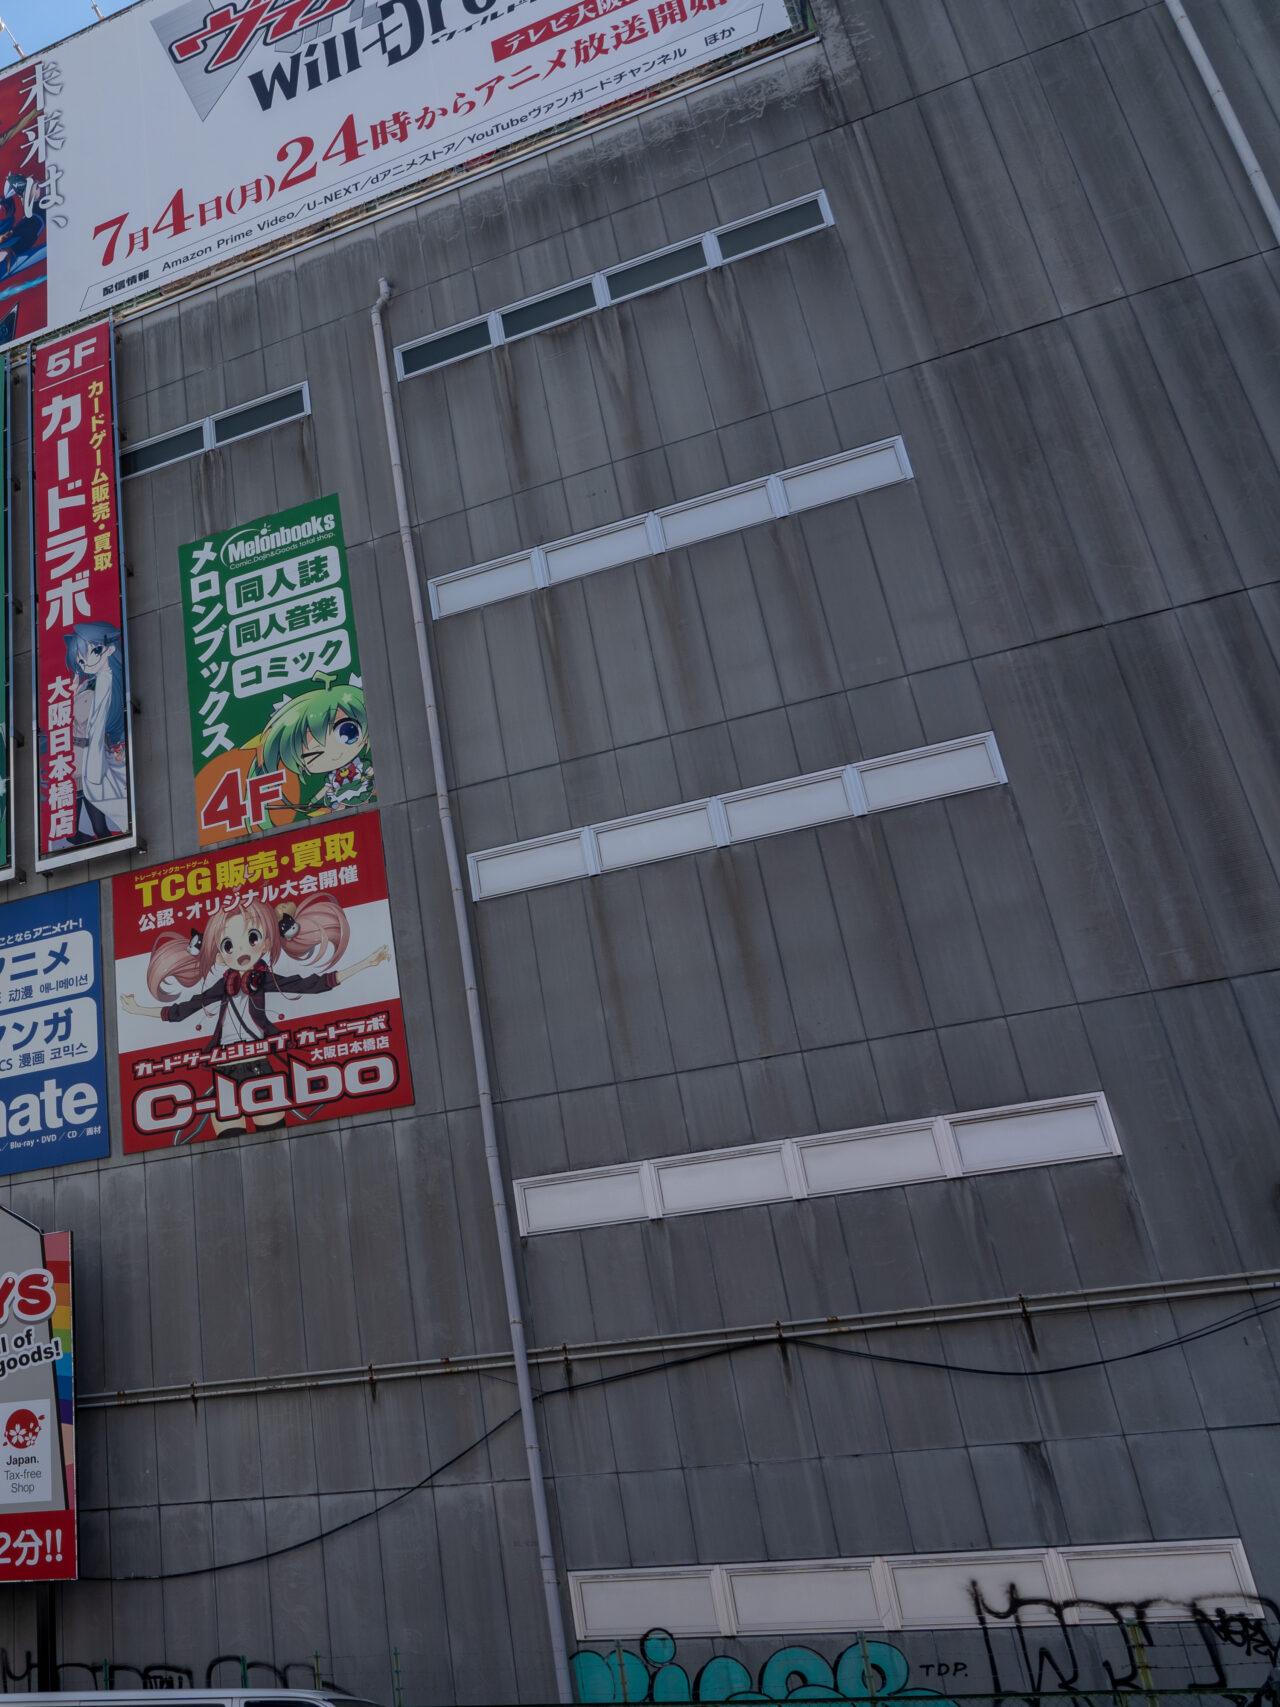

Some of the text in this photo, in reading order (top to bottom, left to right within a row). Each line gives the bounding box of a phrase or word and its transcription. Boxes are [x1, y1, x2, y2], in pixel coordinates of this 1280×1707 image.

[102, 25, 736, 297] 配信情報 Amazon Prime ほか
[46, 337, 97, 378] 5F
[88, 381, 113, 572] カードゲーム販売・買取
[41, 393, 91, 630] カードラボ
[228, 513, 336, 563] Melonbooks
[299, 538, 316, 548] total
[317, 532, 336, 544] shop.
[235, 555, 330, 608] 同人誌
[236, 596, 338, 648] 同人音楽
[190, 541, 235, 758] メロンブックス
[240, 637, 343, 689] コミック
[48, 675, 74, 839] 大阪日本橋店
[200, 768, 287, 833] 4F
[39, 973, 88, 993] 애니메이션
[18, 1050, 45, 1069] 漫画
[50, 1042, 88, 1061] 코믹스
[134, 1012, 389, 1077] カードゲームショップ カードラボ
[310, 1036, 390, 1063] 大阪日本橋店
[134, 1055, 397, 1133] C-labo
[13, 1329, 34, 1350] of
[4, 1469, 42, 1480] Tax-free
[6, 1455, 39, 1467] Japan.
[10, 1483, 35, 1495] Shop
